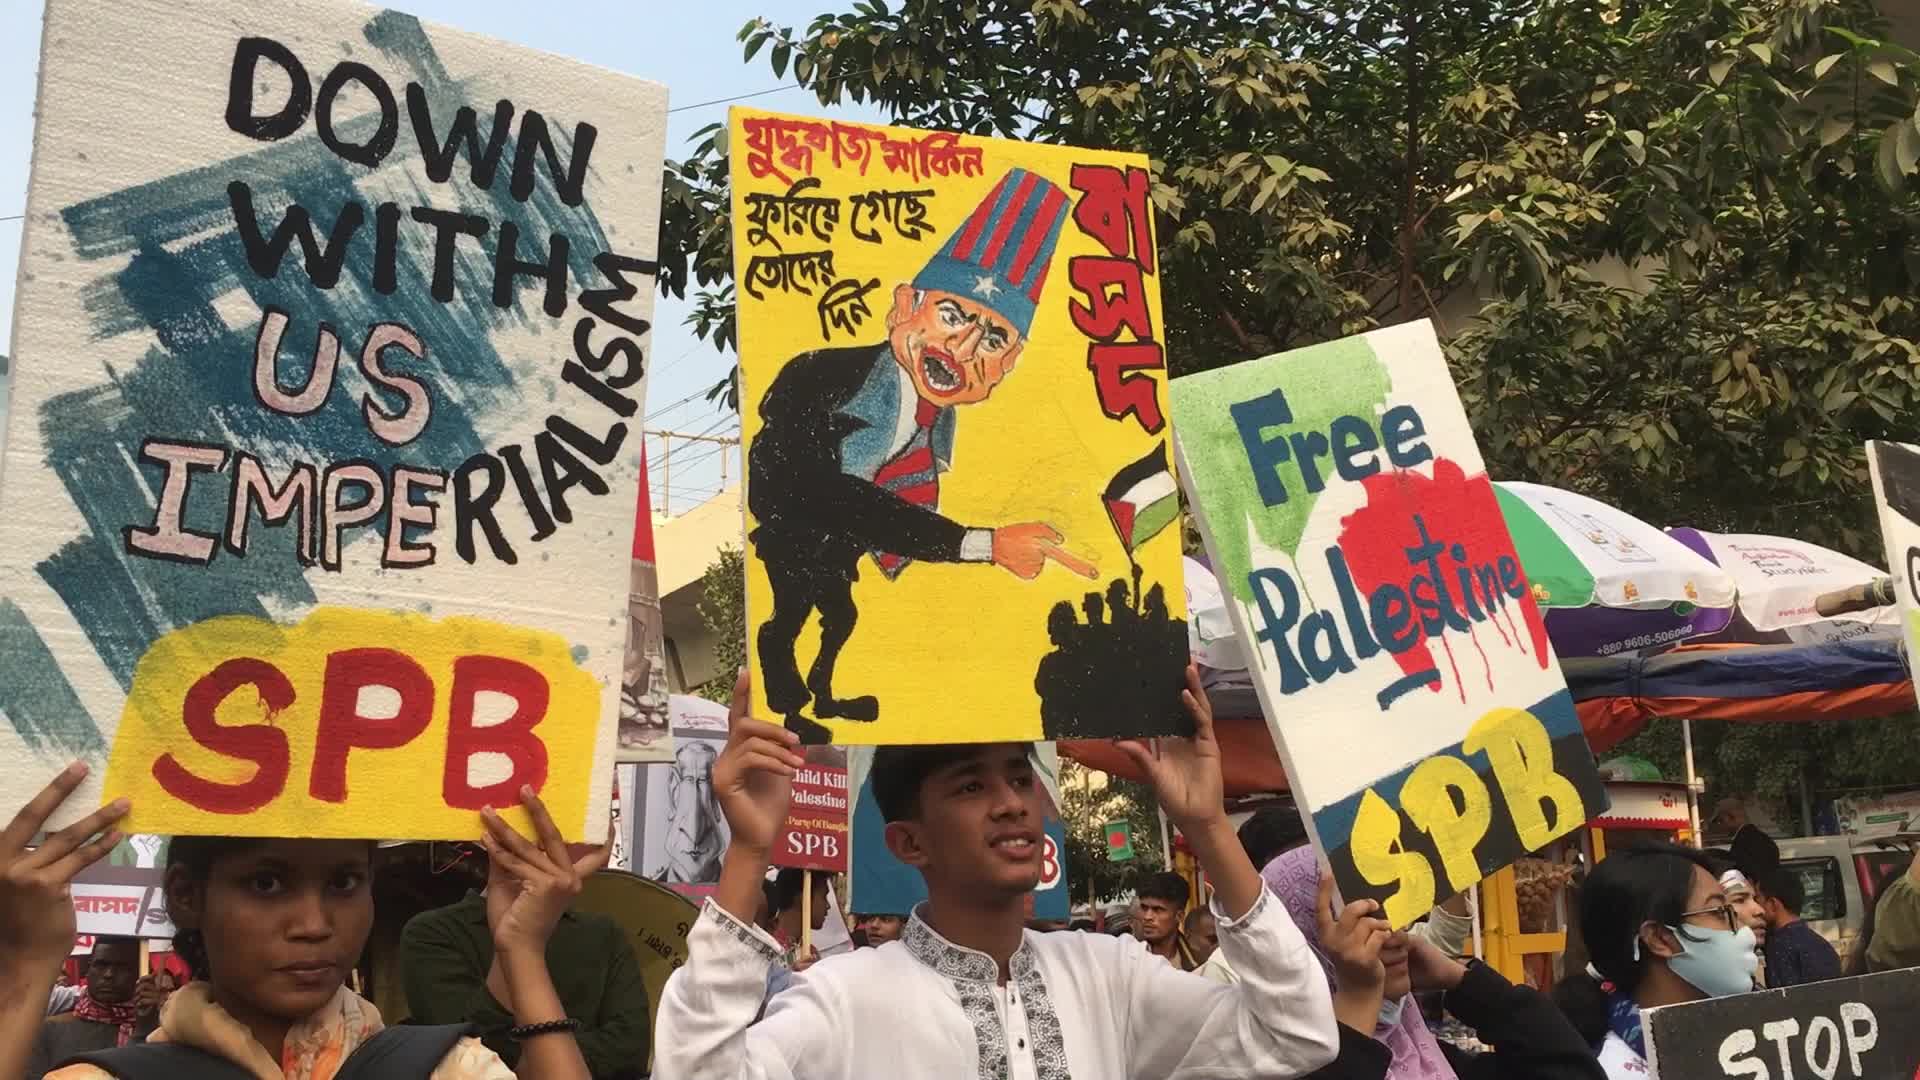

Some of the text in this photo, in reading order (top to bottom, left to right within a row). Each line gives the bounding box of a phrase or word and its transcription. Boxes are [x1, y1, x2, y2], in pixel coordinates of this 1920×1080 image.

[225, 37, 597, 205] DOWN
[880, 132, 983, 183] মার্কিন
[227, 181, 570, 317] WITH
[745, 250, 836, 300] তোদের
[849, 189, 936, 244] গেছে
[818, 278, 881, 342] দিন
[121, 250, 658, 571] IMPERIALISM
[252, 304, 432, 446] US
[1230, 388, 1433, 507] Free
[1248, 514, 1525, 694] Palestine
[1598, 624, 1693, 655] +880 9606-506060
[152, 646, 550, 814] SPB
[787, 831, 839, 857] SPB
[1350, 707, 1585, 932] SPB
[1718, 1002, 1878, 1080] STOP
